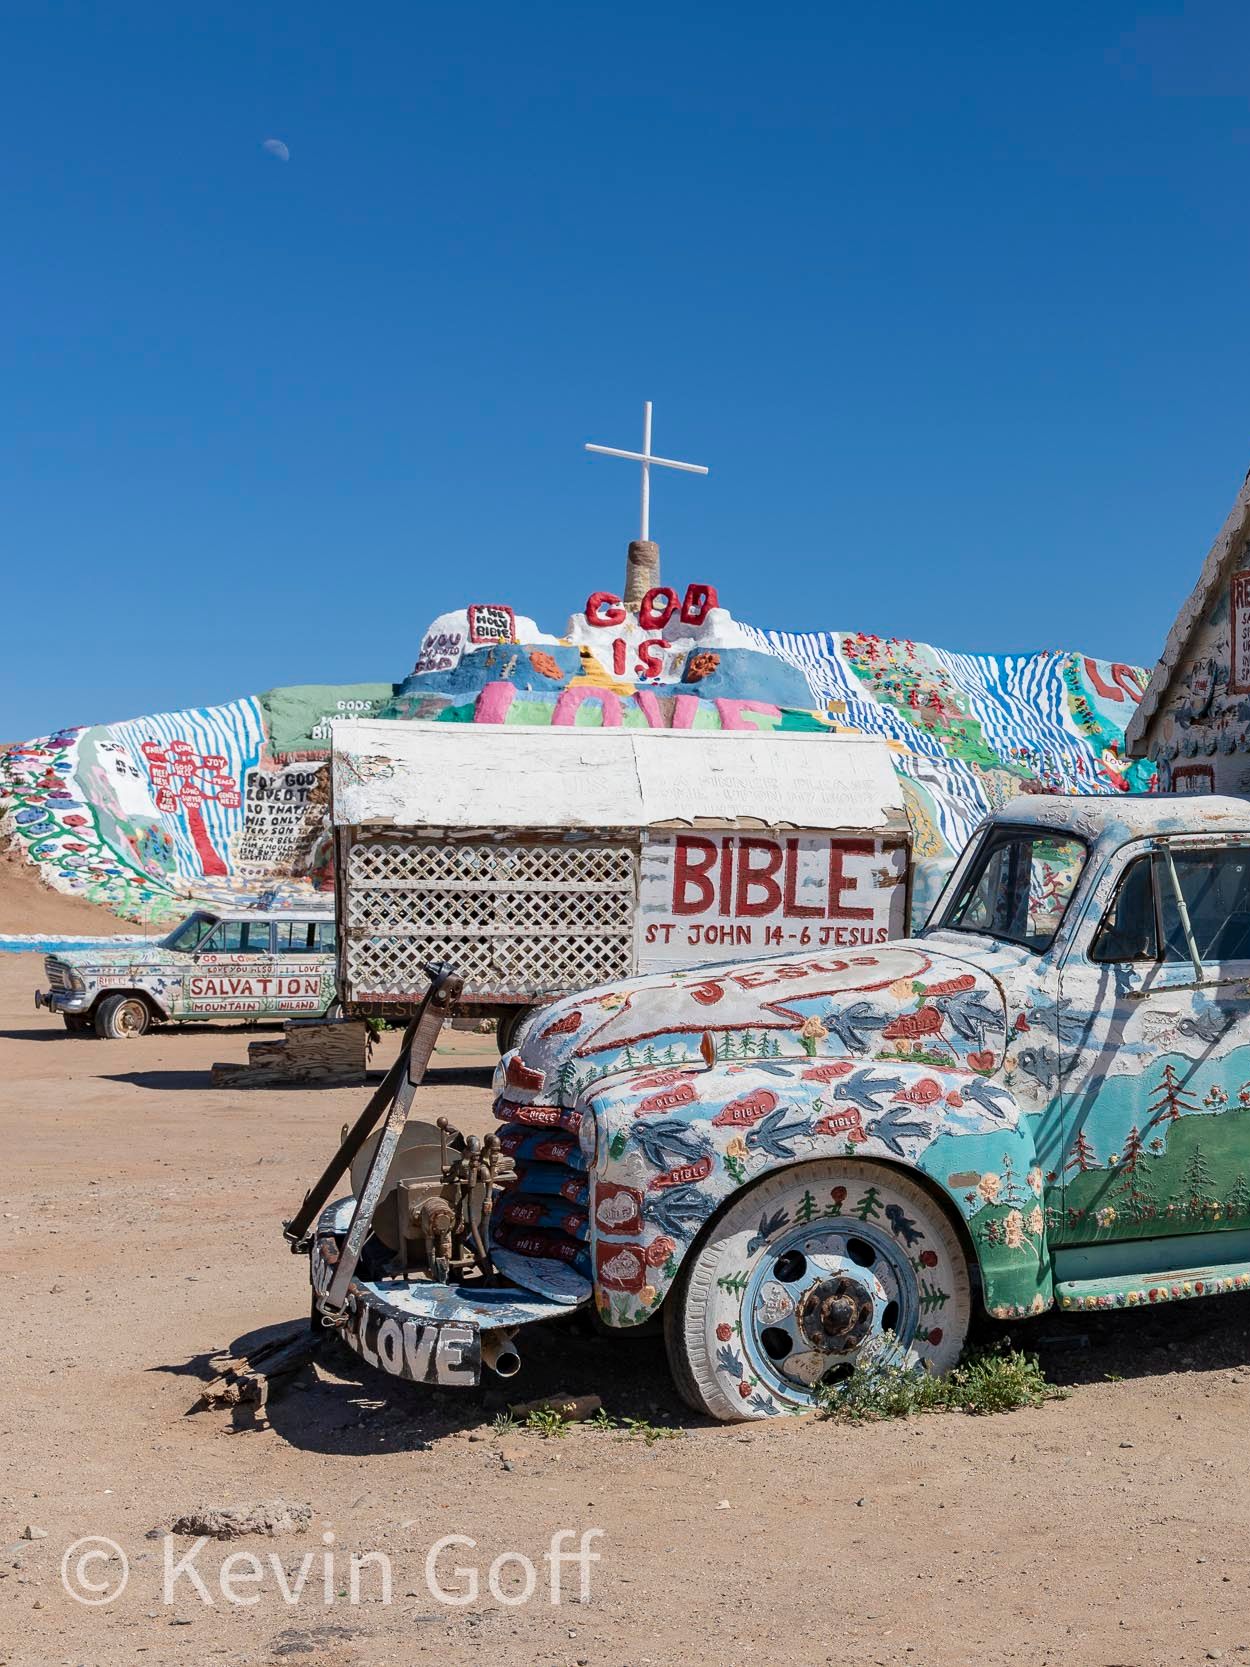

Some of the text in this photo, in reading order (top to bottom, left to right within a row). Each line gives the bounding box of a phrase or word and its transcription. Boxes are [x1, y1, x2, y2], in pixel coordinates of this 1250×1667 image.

[586, 584, 719, 630] GOD
[476, 615, 508, 629] HOLY
[476, 626, 510, 639] BIBLE
[426, 633, 461, 648] YOU
[612, 638, 672, 678] IS
[336, 701, 371, 711] GODS
[206, 758, 226, 768] JOY
[247, 789, 293, 801] LOVED
[245, 815, 267, 827] HIS
[271, 816, 301, 827] ONLY
[271, 826, 294, 835] SON
[672, 835, 876, 921] BIBLE
[645, 924, 676, 944] ST
[688, 925, 752, 945] JOHN
[818, 927, 889, 945] JESUS
[229, 965, 248, 974] YOU
[298, 965, 321, 973] LOVE
[190, 977, 320, 997] SALVATION
[683, 956, 881, 1005] JESUS
[194, 1001, 257, 1012] MOUNTAIN
[655, 1091, 690, 1108] BIBLE
[529, 1110, 561, 1123] BIBLE
[732, 1103, 767, 1121] BIBLE
[828, 1114, 858, 1129] BIBLE
[672, 1166, 706, 1182] BIBLE
[360, 1302, 475, 1386] LOVE
